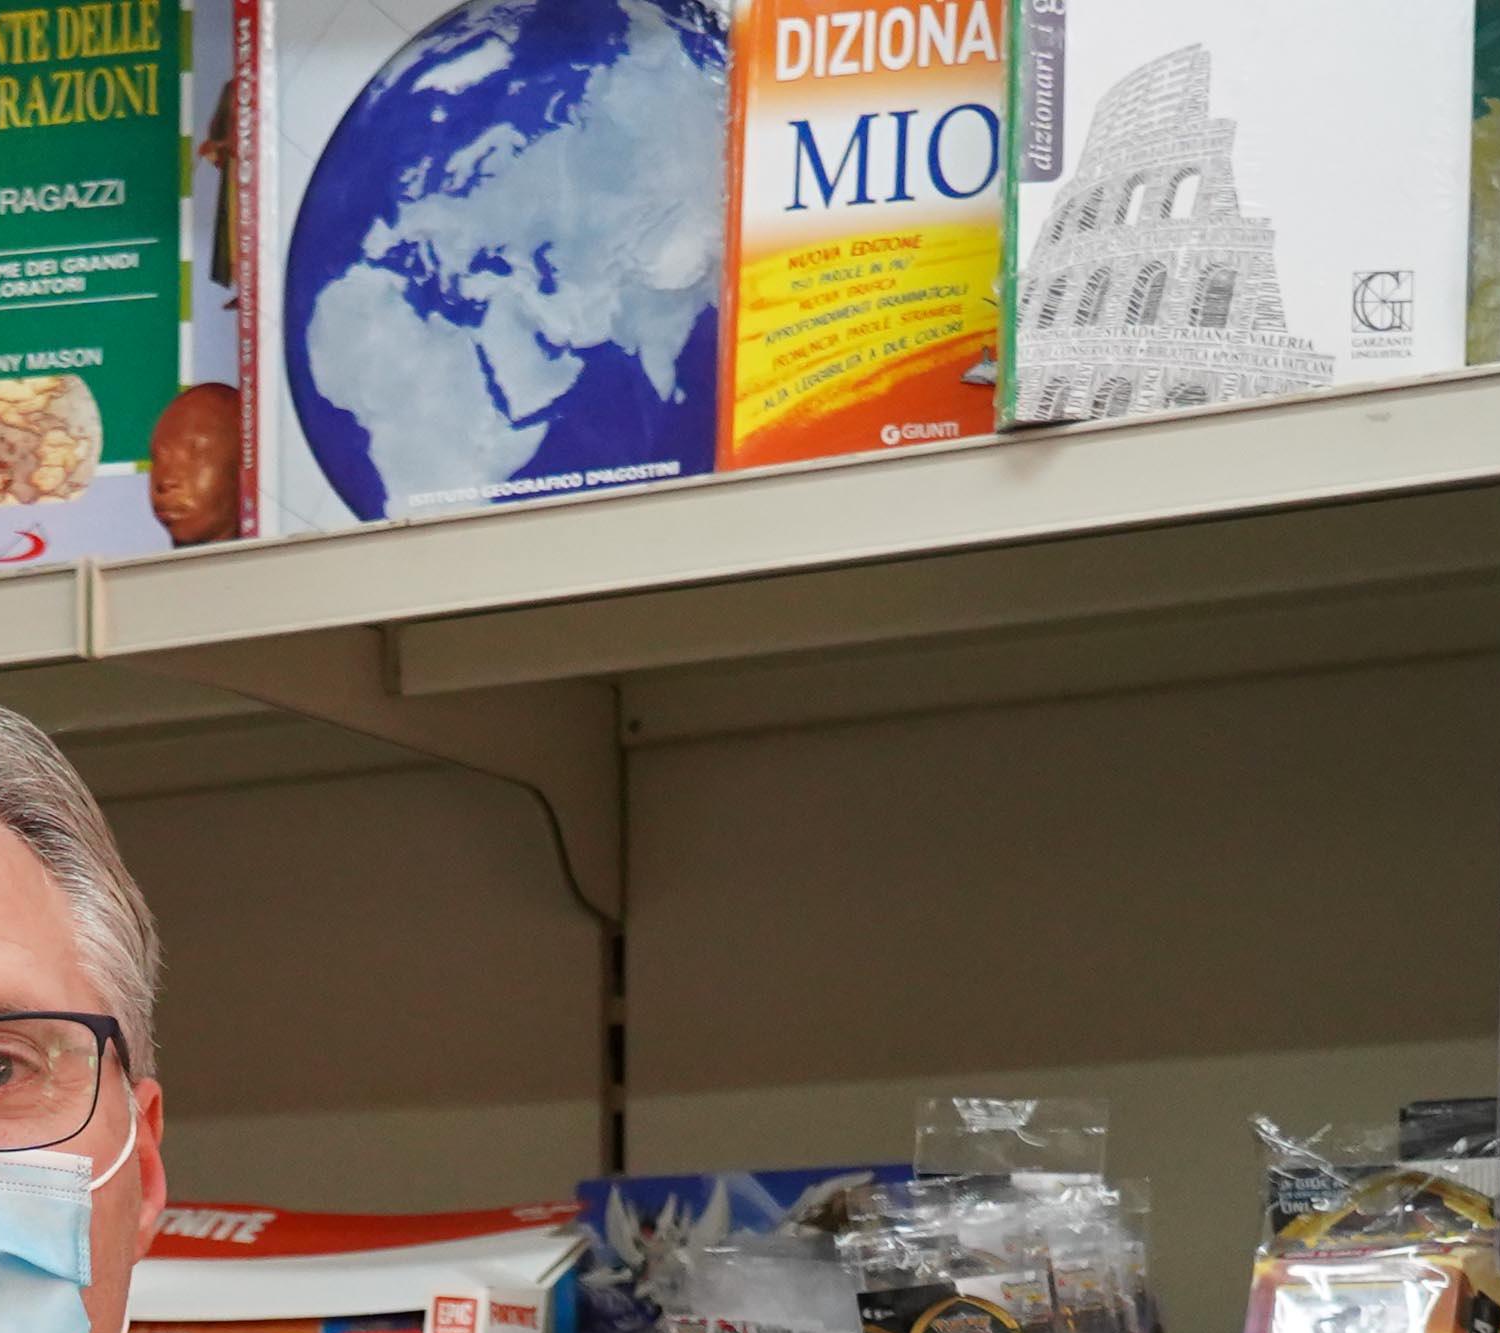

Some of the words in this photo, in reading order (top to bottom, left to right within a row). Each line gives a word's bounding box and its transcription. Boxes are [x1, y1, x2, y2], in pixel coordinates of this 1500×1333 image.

[58, 0, 161, 57] DELLE
[1027, 49, 1055, 173] dizionari
[785, 103, 999, 211] MIO
[0, 180, 125, 216] RAGAZZI
[25, 257, 58, 276] DEI
[62, 252, 139, 275] GRANDI
[788, 243, 841, 271] NUOVA
[850, 233, 924, 258] EDIZIONE
[26, 348, 103, 370] MASON
[1248, 333, 1314, 352] VALERIA
[902, 421, 960, 439] GIUNTI
